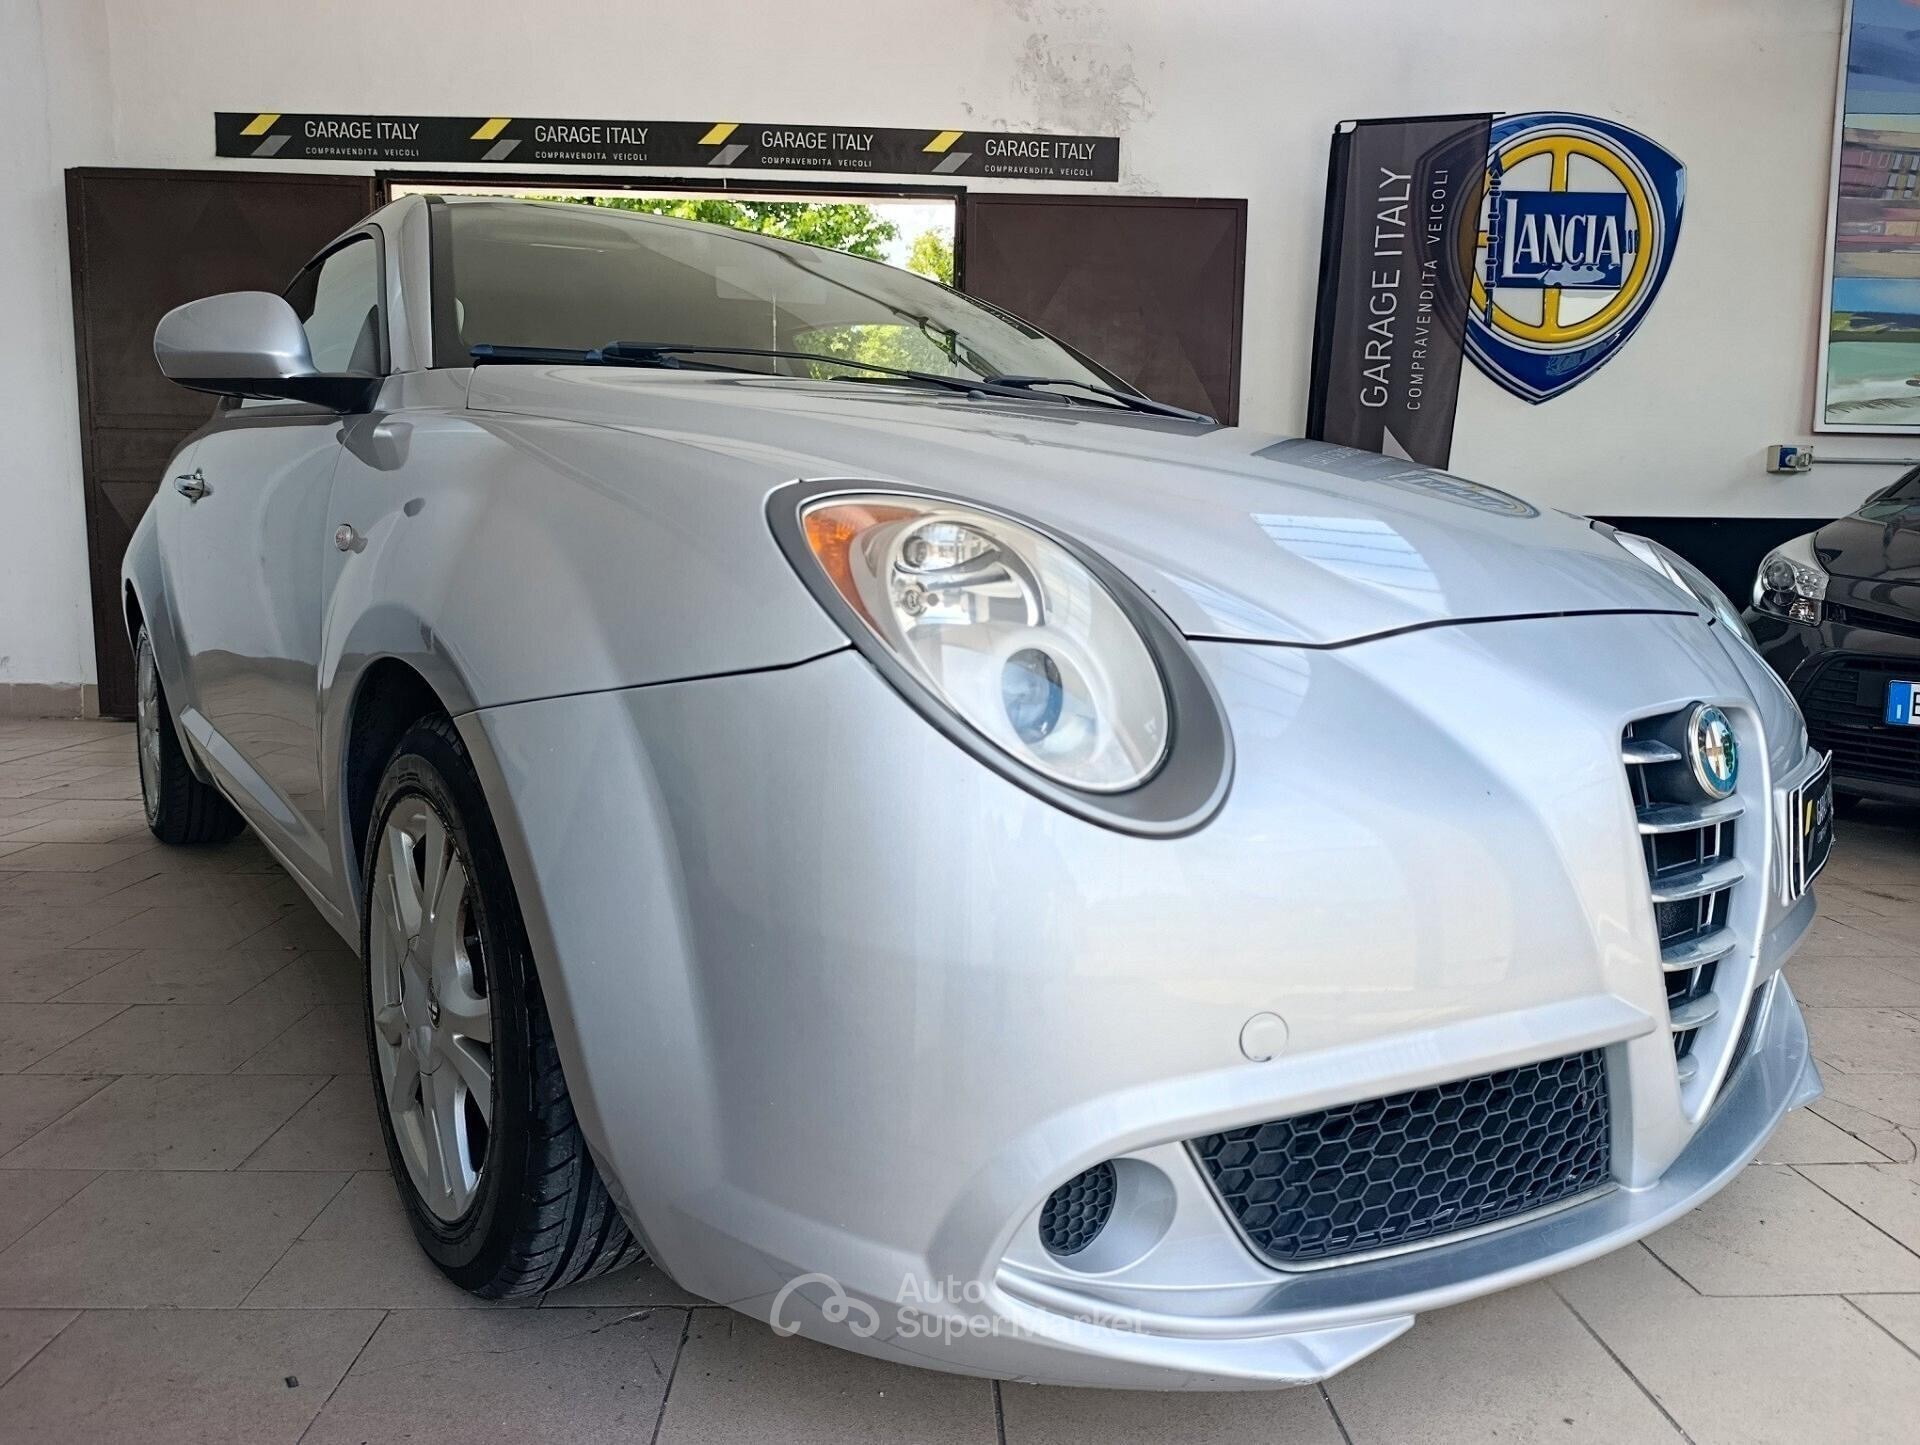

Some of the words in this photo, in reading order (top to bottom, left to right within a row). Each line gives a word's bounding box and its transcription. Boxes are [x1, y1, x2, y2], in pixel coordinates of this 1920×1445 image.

[304, 121, 372, 139] GARAGE
[376, 122, 420, 140] ITALY
[534, 125, 602, 144] GARAGE
[606, 127, 649, 145] ITALY
[761, 130, 827, 150] GARAGE
[832, 133, 874, 151] ITALY
[305, 147, 378, 156] COMPRAVENDITA
[384, 149, 420, 157] VEICOLI
[535, 151, 607, 160] COMPRAVENDITA
[613, 153, 648, 161] VEICOLI
[985, 139, 1050, 158] GARAGE
[1054, 142, 1096, 160] ITALY
[761, 156, 832, 166] COMPRAVENDITA
[838, 160, 872, 168] VEICOLI
[984, 164, 1054, 175] COMPRAVENDITA
[1060, 168, 1094, 177] VEICOLI
[1374, 166, 1412, 257] ITALY
[1500, 197, 1622, 280] LANCIA
[1407, 259, 1438, 411] COMPRAVENDITA
[1426, 169, 1449, 246] VEICOLI
[1360, 269, 1400, 409] GARAGE
